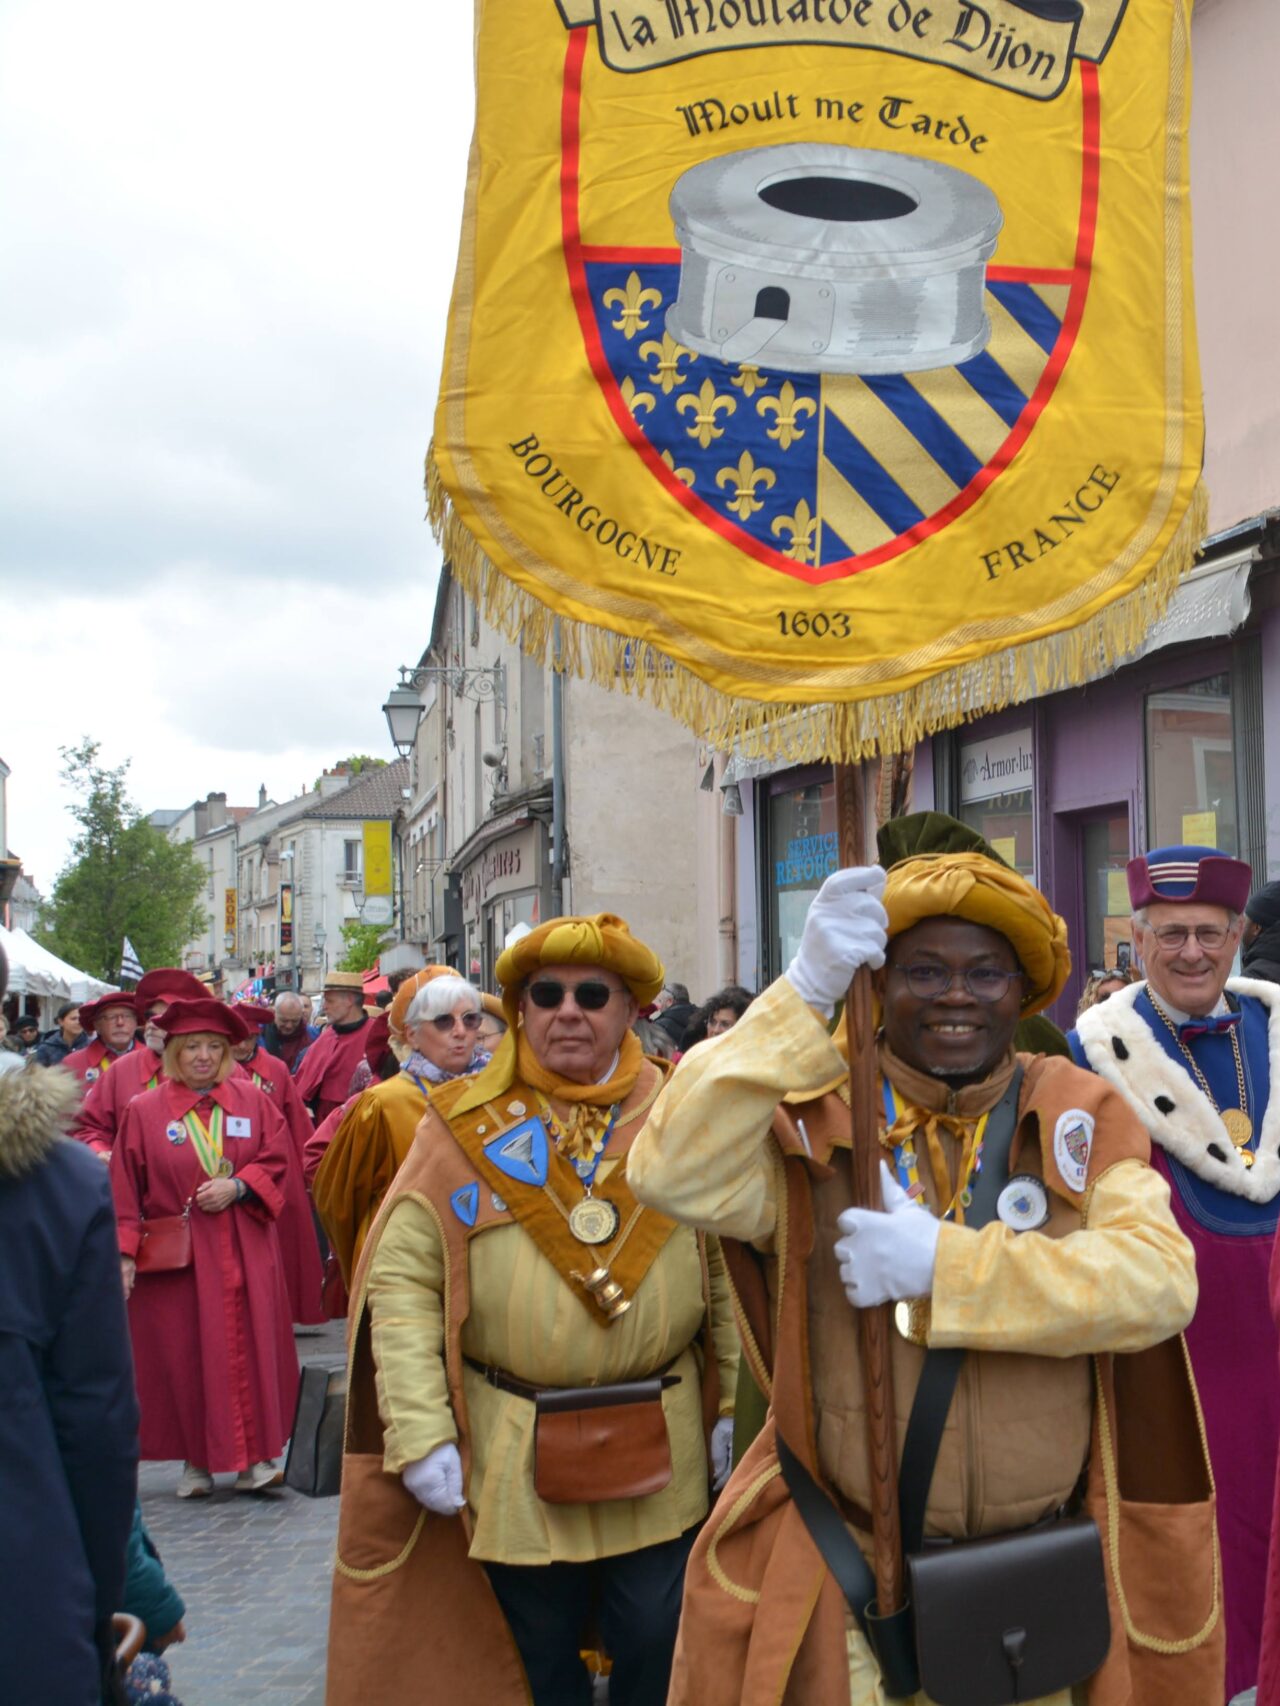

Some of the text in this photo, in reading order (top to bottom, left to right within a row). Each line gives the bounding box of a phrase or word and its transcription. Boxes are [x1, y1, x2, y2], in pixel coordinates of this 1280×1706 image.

[888, 0, 933, 38] de
[943, 0, 1056, 80] Dijon
[675, 91, 988, 154] Moult me Tarde
[509, 433, 682, 576] BOURGOGNE
[979, 464, 1121, 581] FRANCE
[776, 611, 852, 639] 1603
